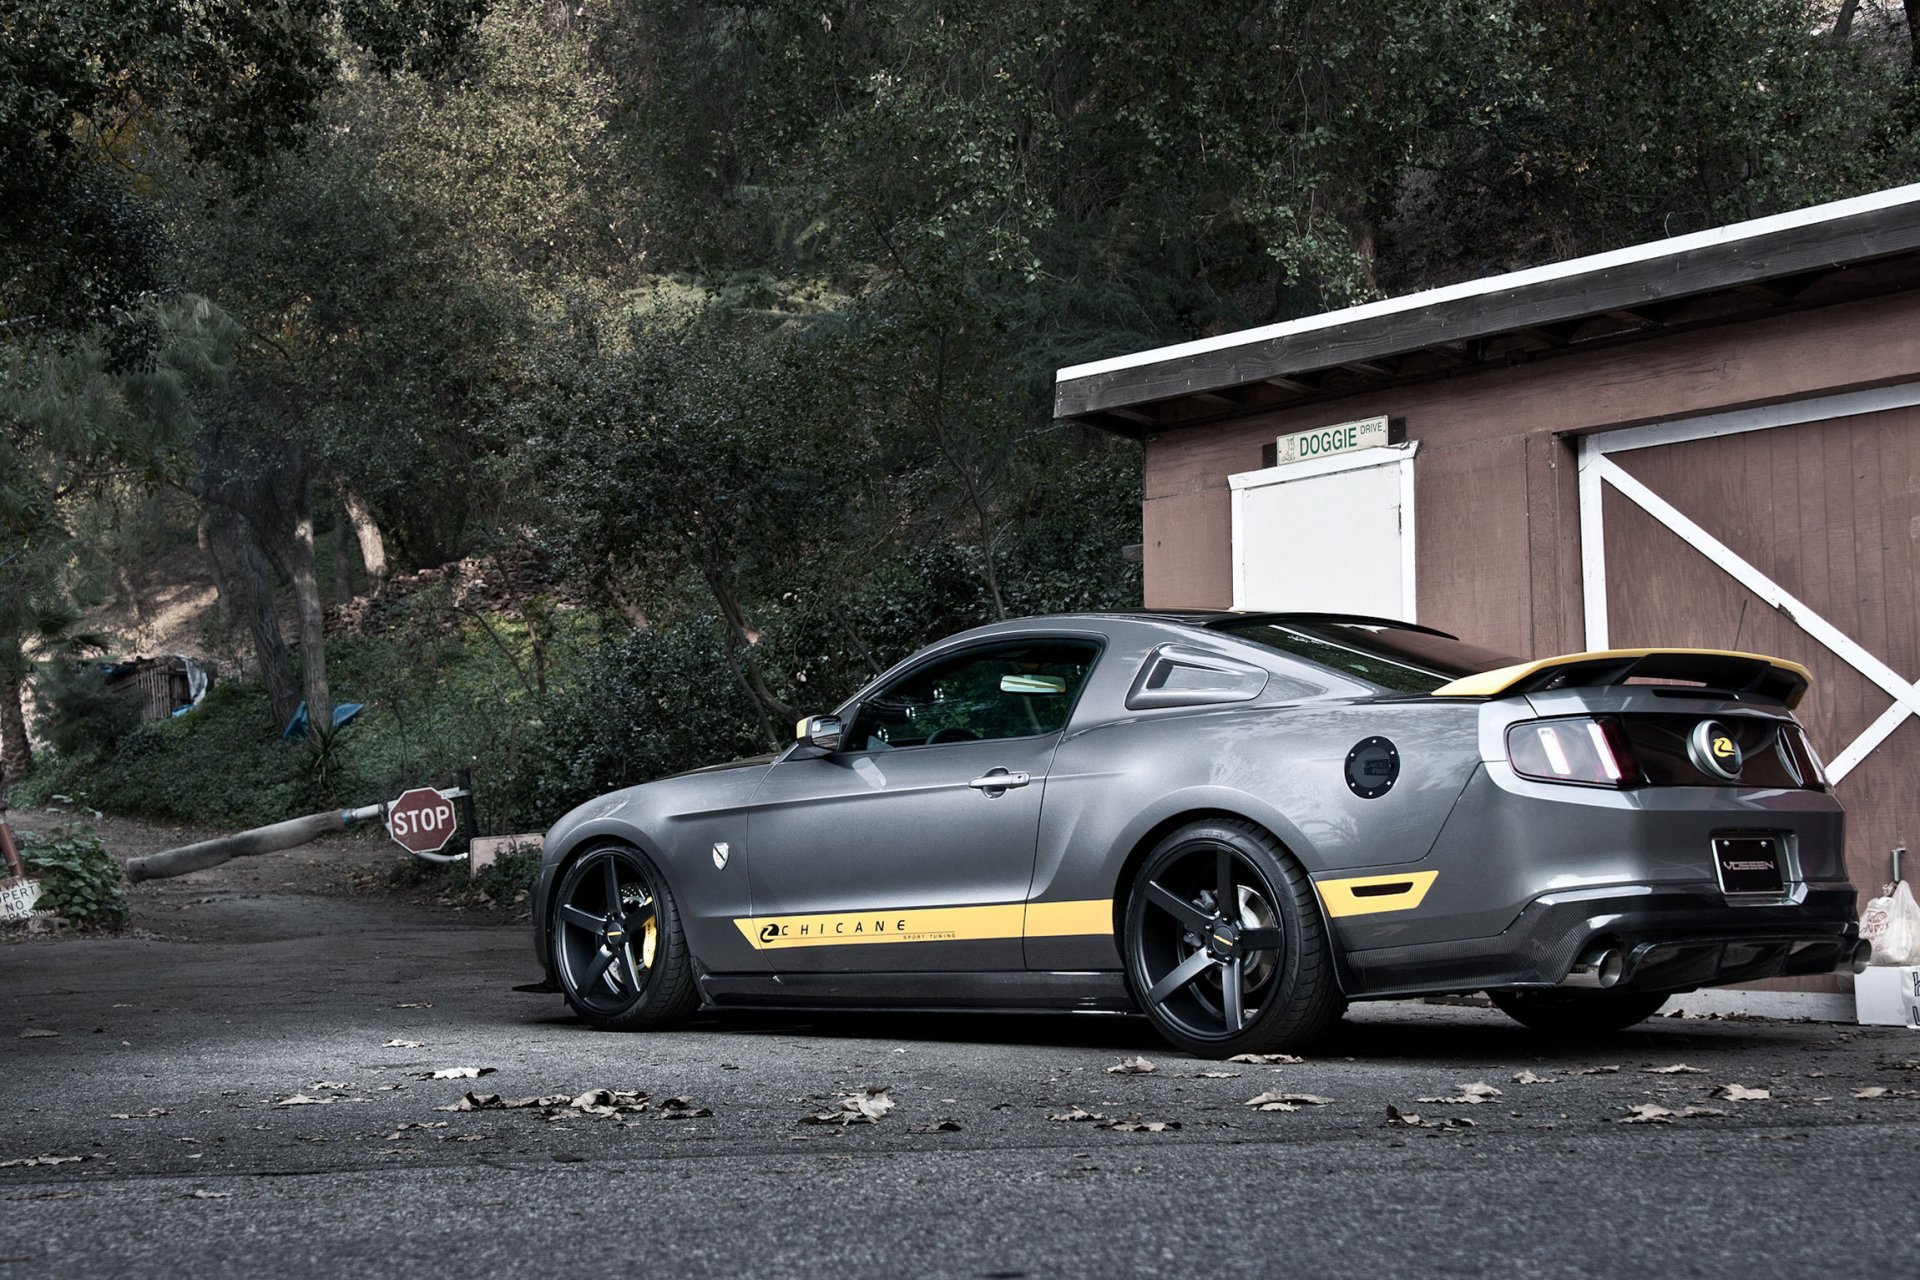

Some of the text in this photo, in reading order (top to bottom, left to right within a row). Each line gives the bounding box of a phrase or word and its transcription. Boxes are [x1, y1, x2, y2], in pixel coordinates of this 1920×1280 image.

[1300, 422, 1383, 457] DOGGIE DRIVE
[393, 805, 450, 836] STOP
[1722, 860, 1775, 871] VOSSEN
[5, 900, 24, 913] NO
[781, 919, 906, 936] CHICANE
[903, 932, 957, 941] SPORT TUNING
